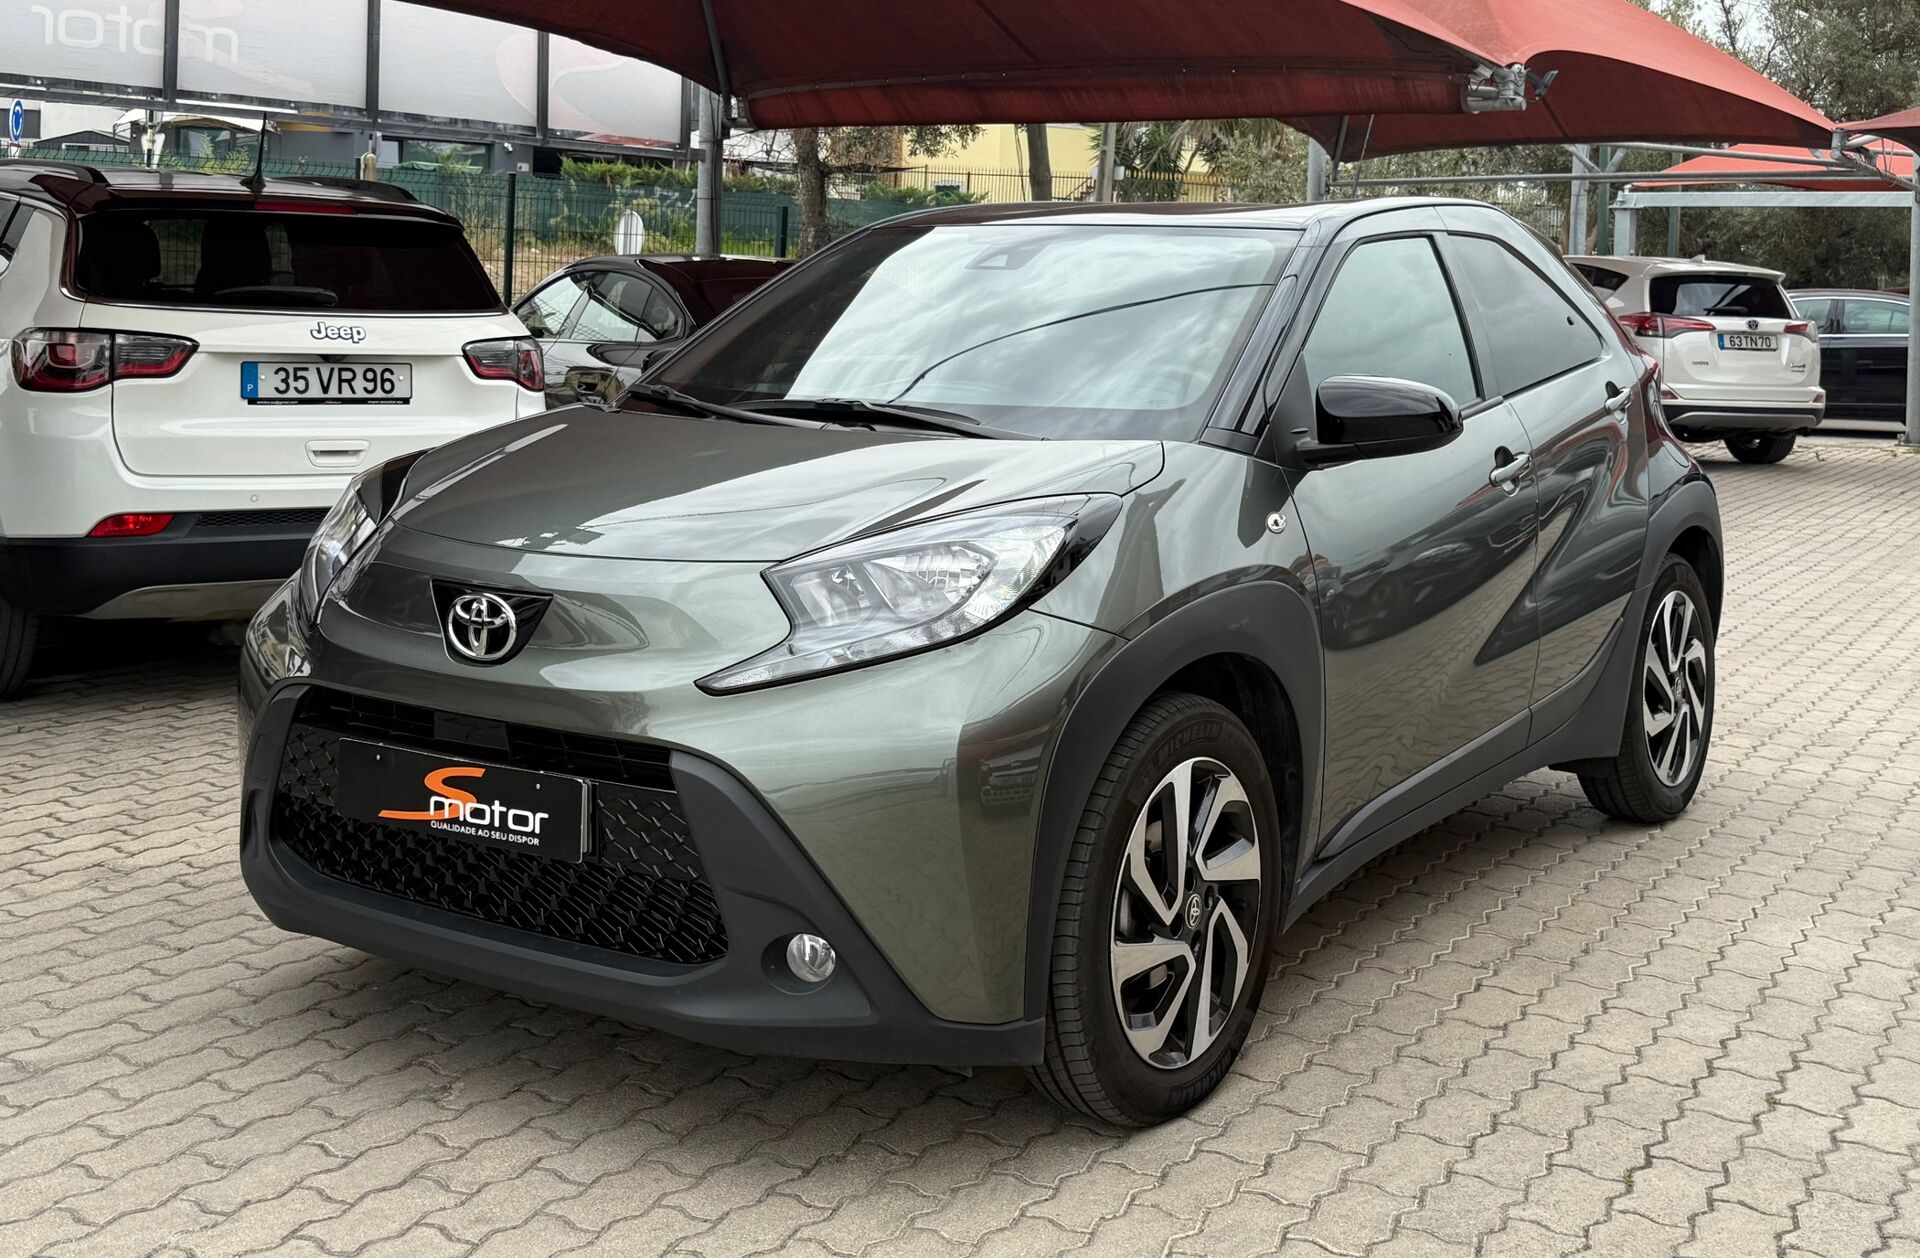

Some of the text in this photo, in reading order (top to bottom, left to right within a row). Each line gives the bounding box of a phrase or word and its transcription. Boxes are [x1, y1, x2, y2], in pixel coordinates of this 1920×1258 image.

[310, 321, 366, 343] Jeep
[1158, 722, 1220, 767] MICHELIN
[429, 795, 549, 834] motor
[430, 820, 540, 847] QUALIDADE AO SEU DISPOR
